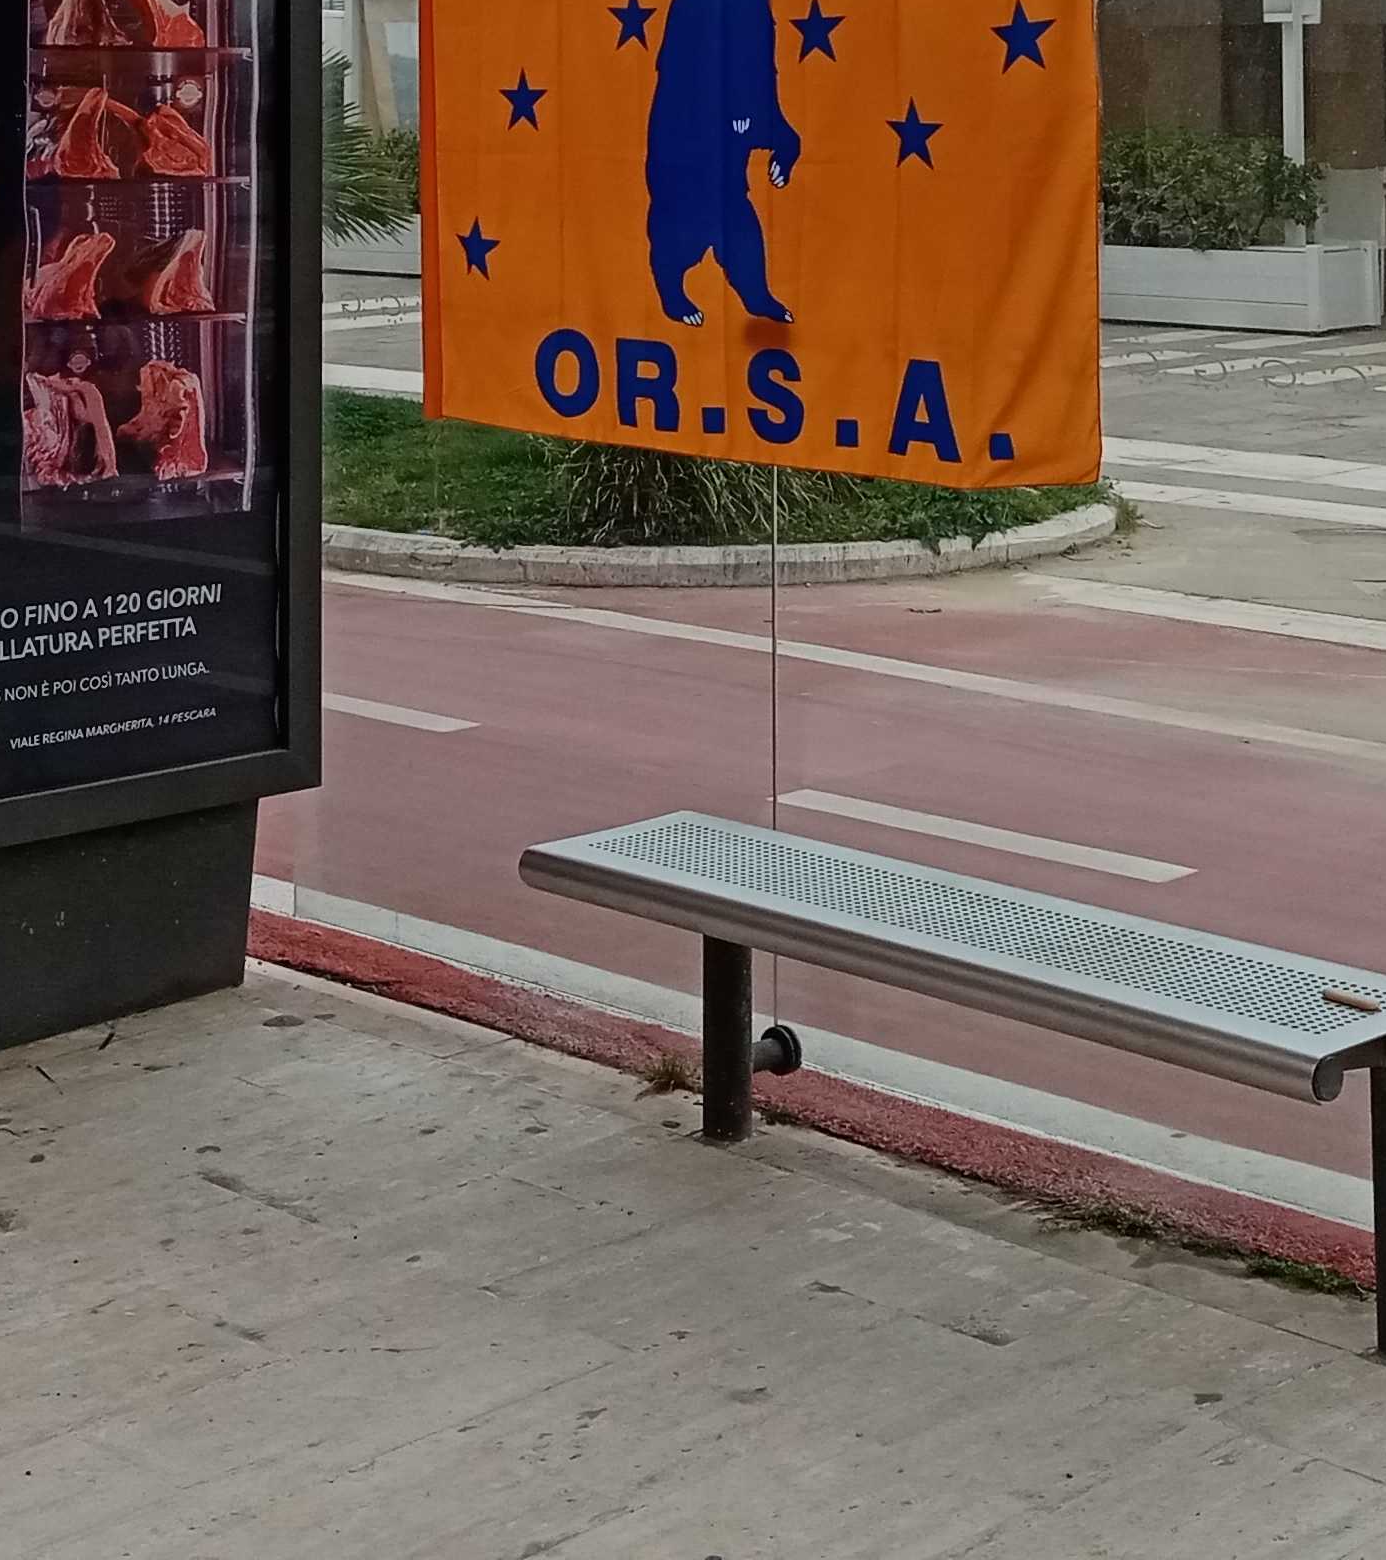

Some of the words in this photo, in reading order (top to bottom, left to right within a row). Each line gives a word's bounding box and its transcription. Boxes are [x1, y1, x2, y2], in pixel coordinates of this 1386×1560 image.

[24, 600, 78, 627] FINO
[82, 596, 99, 619] A
[104, 591, 141, 616] 120
[146, 583, 222, 611] GIORNI
[98, 615, 197, 649] PERFETTA
[4, 684, 38, 702] NON
[41, 676, 50, 697] È
[53, 679, 77, 696] POI
[80, 671, 113, 692] COSÌ
[115, 667, 159, 686] TANTO
[162, 661, 210, 681] LUNGA.
[10, 735, 40, 750] VIALE
[42, 728, 84, 745] REGINA
[158, 715, 170, 726] 14
[171, 707, 216, 724] PESCARA
